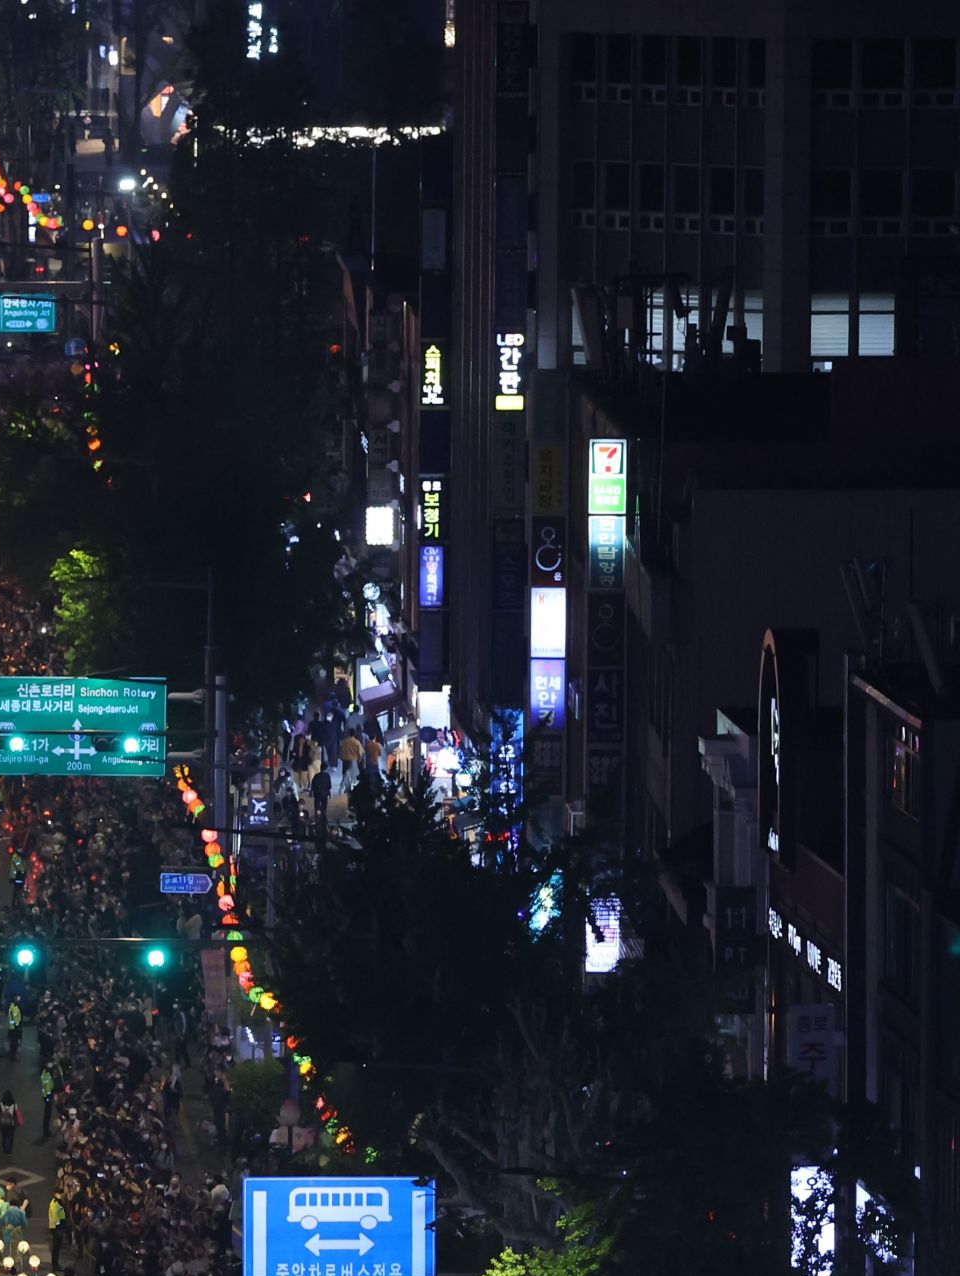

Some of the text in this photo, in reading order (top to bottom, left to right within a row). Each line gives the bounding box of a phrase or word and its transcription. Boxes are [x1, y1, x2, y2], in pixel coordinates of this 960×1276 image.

[496, 333, 525, 346] LED
[499, 347, 521, 394] 간판
[424, 492, 440, 538] 보청기
[534, 675, 561, 690] 연세
[17, 683, 75, 698] 신촌로터리
[80, 687, 156, 700] Sinchon Rotary
[0, 700, 74, 713] 세종대로사거리
[78, 704, 139, 716] Sejong-daero Jct
[724, 906, 747, 929] 1:1
